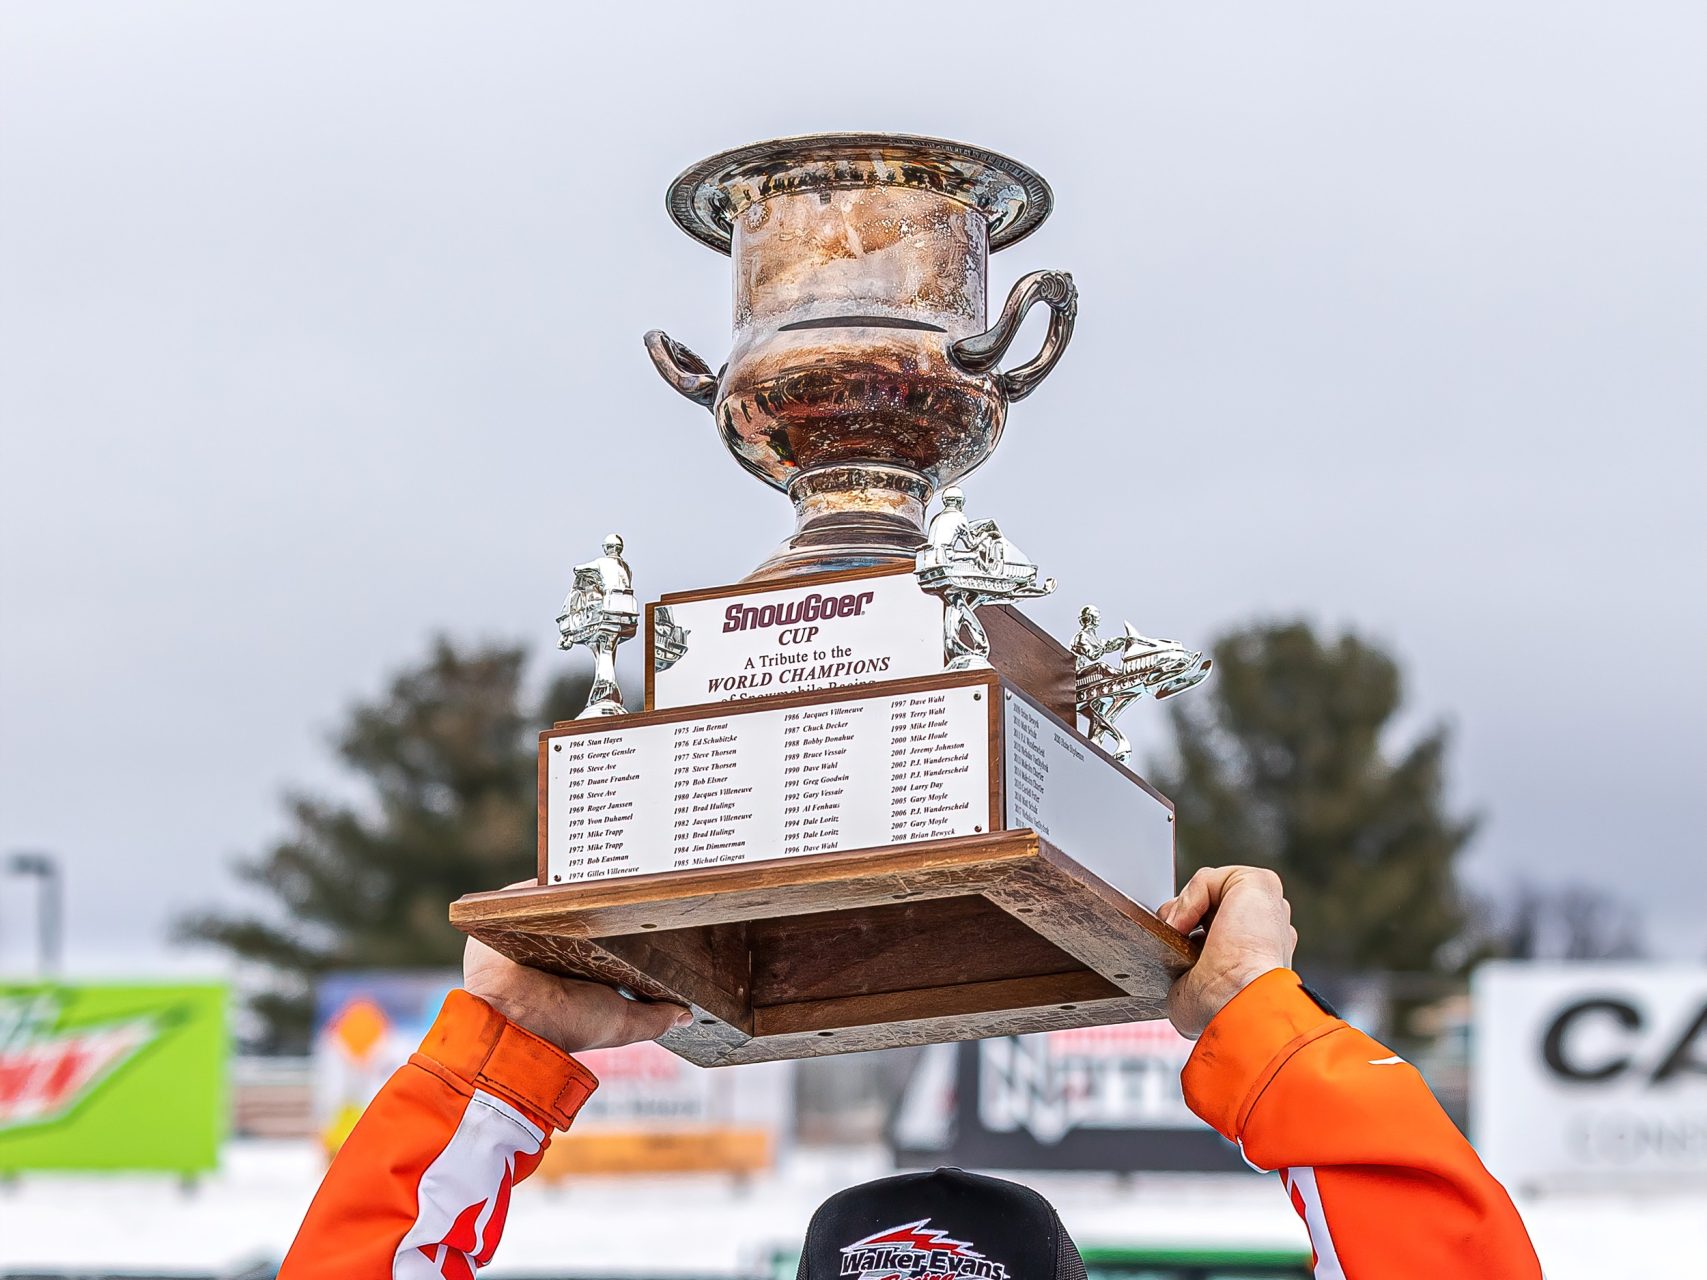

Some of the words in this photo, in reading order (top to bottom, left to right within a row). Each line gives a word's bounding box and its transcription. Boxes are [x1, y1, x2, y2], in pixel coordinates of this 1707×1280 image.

[778, 626, 819, 646] CUP
[744, 656, 755, 670] A
[759, 651, 808, 668] Tribute
[813, 649, 826, 661] to
[831, 645, 852, 659] the
[708, 672, 773, 694] WORLD
[779, 656, 891, 684] CHAMPIONS
[891, 700, 906, 708] 1997
[784, 713, 799, 721] 1986
[831, 707, 863, 715] Villeneuve
[891, 712, 906, 720] 1998
[929, 707, 945, 715] Wahl
[784, 727, 800, 735] 1987
[803, 724, 823, 732] Chuck
[825, 721, 848, 730] Decker
[928, 720, 948, 728] Houle
[674, 727, 689, 735] 1975
[928, 732, 948, 740] Houle
[674, 740, 689, 748] 1976
[703, 735, 737, 745] Schubitzke
[785, 740, 800, 748] 1988
[803, 737, 823, 746] Bobby
[825, 734, 854, 743] Donahue
[674, 753, 690, 762] 1977
[711, 749, 736, 757] Thorsen
[785, 753, 800, 761] 1989
[825, 748, 847, 756] Vessair
[891, 748, 906, 757] 2001
[935, 743, 964, 751] Johnston
[569, 753, 584, 761] 1965
[891, 761, 907, 769] 2002
[924, 753, 968, 765] Wanderscheid
[569, 767, 584, 775] 1966
[674, 767, 689, 775] 1978
[821, 762, 838, 770] Wahl
[891, 773, 906, 781] 2003
[924, 765, 968, 777] Wanderscheid
[569, 780, 584, 788] 1967
[587, 778, 608, 786] Duane
[610, 774, 639, 783] Frandsen
[674, 780, 689, 788] 1979
[693, 778, 705, 786] Bob
[785, 780, 799, 788] 1991
[821, 774, 849, 783] Goodwin
[674, 793, 689, 801] 1980
[720, 787, 752, 795] Villeneuve
[785, 793, 800, 801] 1992
[821, 788, 843, 796] Vessair
[891, 785, 907, 793] 2004
[569, 793, 584, 801] 1968
[891, 797, 907, 805] 2005
[928, 793, 948, 801] Moyle
[569, 806, 584, 814] 1969
[674, 806, 689, 814] 1981
[693, 804, 709, 812] Brad
[785, 806, 800, 814] 1993
[891, 809, 907, 817] 2006
[924, 802, 969, 813] Wanderscheid
[569, 819, 584, 827] 1970
[604, 813, 633, 823] Duhamel
[674, 820, 689, 828] 1982
[692, 818, 718, 826] Jacques
[720, 814, 752, 822] Villeneuve
[784, 820, 800, 828] 1994
[891, 822, 907, 830] 2007
[910, 820, 927, 828] Gary
[928, 817, 948, 826] Moyle
[569, 832, 583, 840] 1971
[587, 830, 603, 838] Mike
[605, 829, 623, 837] Trapp
[674, 833, 689, 841] 1983
[692, 830, 708, 839] Brad
[785, 833, 800, 841] 1995
[803, 831, 818, 839] Dale
[820, 829, 839, 837] Loritz
[569, 845, 584, 853] 1972
[605, 842, 623, 850] Trapp
[674, 846, 689, 854] 1984
[706, 841, 745, 850] Dimmerman
[785, 846, 799, 854] 1996
[569, 859, 584, 867] 1973
[601, 855, 629, 863] Eastman
[674, 859, 689, 867] 1985
[693, 856, 718, 864] Michael
[569, 872, 584, 880] 1974
[607, 867, 639, 875] Villeneuve
[840, 1249, 927, 1276] Walker
